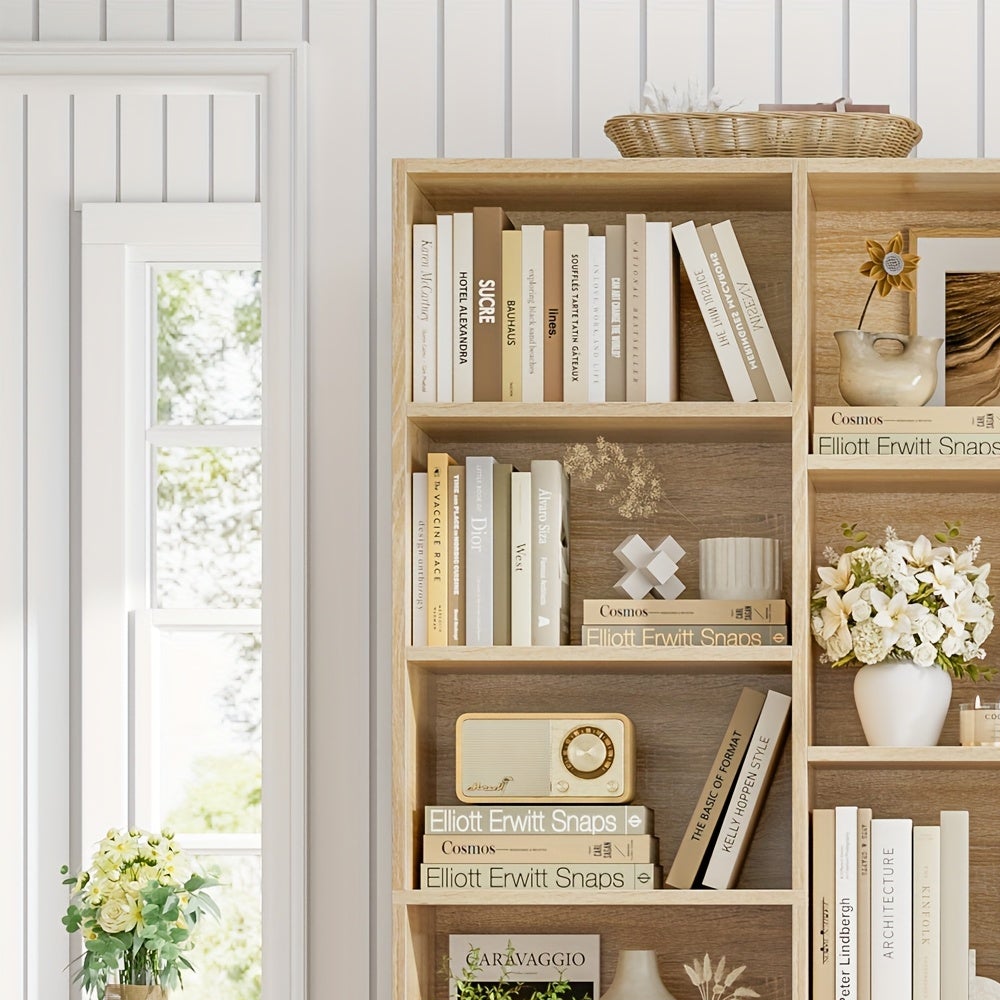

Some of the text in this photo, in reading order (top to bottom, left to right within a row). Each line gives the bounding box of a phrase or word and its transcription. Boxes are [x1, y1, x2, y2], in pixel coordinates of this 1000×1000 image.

[420, 240, 433, 268] Karen
[527, 269, 536, 303] exploring
[571, 254, 579, 291] SOUFFLÉS
[422, 271, 433, 321] McCartney
[478, 280, 496, 324] SUCRE
[459, 271, 468, 365] HOTEL ALEXANDRA
[507, 300, 516, 346] BAUHAUS
[529, 306, 537, 325] black
[548, 308, 558, 339] lines.
[529, 346, 537, 374] beaches
[571, 346, 580, 382] GÂTEAUX
[831, 412, 883, 425] Cosmos
[818, 436, 870, 455] Elliott
[877, 436, 931, 455] Erwitt
[538, 488, 552, 544] Álvaro Siza
[416, 521, 425, 555] design
[471, 517, 487, 552] Dior
[515, 544, 526, 572] West
[600, 604, 648, 617] Cosmos
[587, 628, 636, 646] Elliott
[642, 628, 694, 646] Erwitt
[691, 730, 742, 841] THE BASIC OF FORMAT
[722, 735, 769, 853] KELLY HOPPEN STYLE
[430, 810, 617, 835] Elliott Erwitt Snaps
[442, 841, 496, 854] Cosmos
[427, 868, 624, 890] Elliott Erwitt Snaps
[883, 847, 894, 959] ARCHITECTURE
[839, 898, 853, 965] Lindbergh
